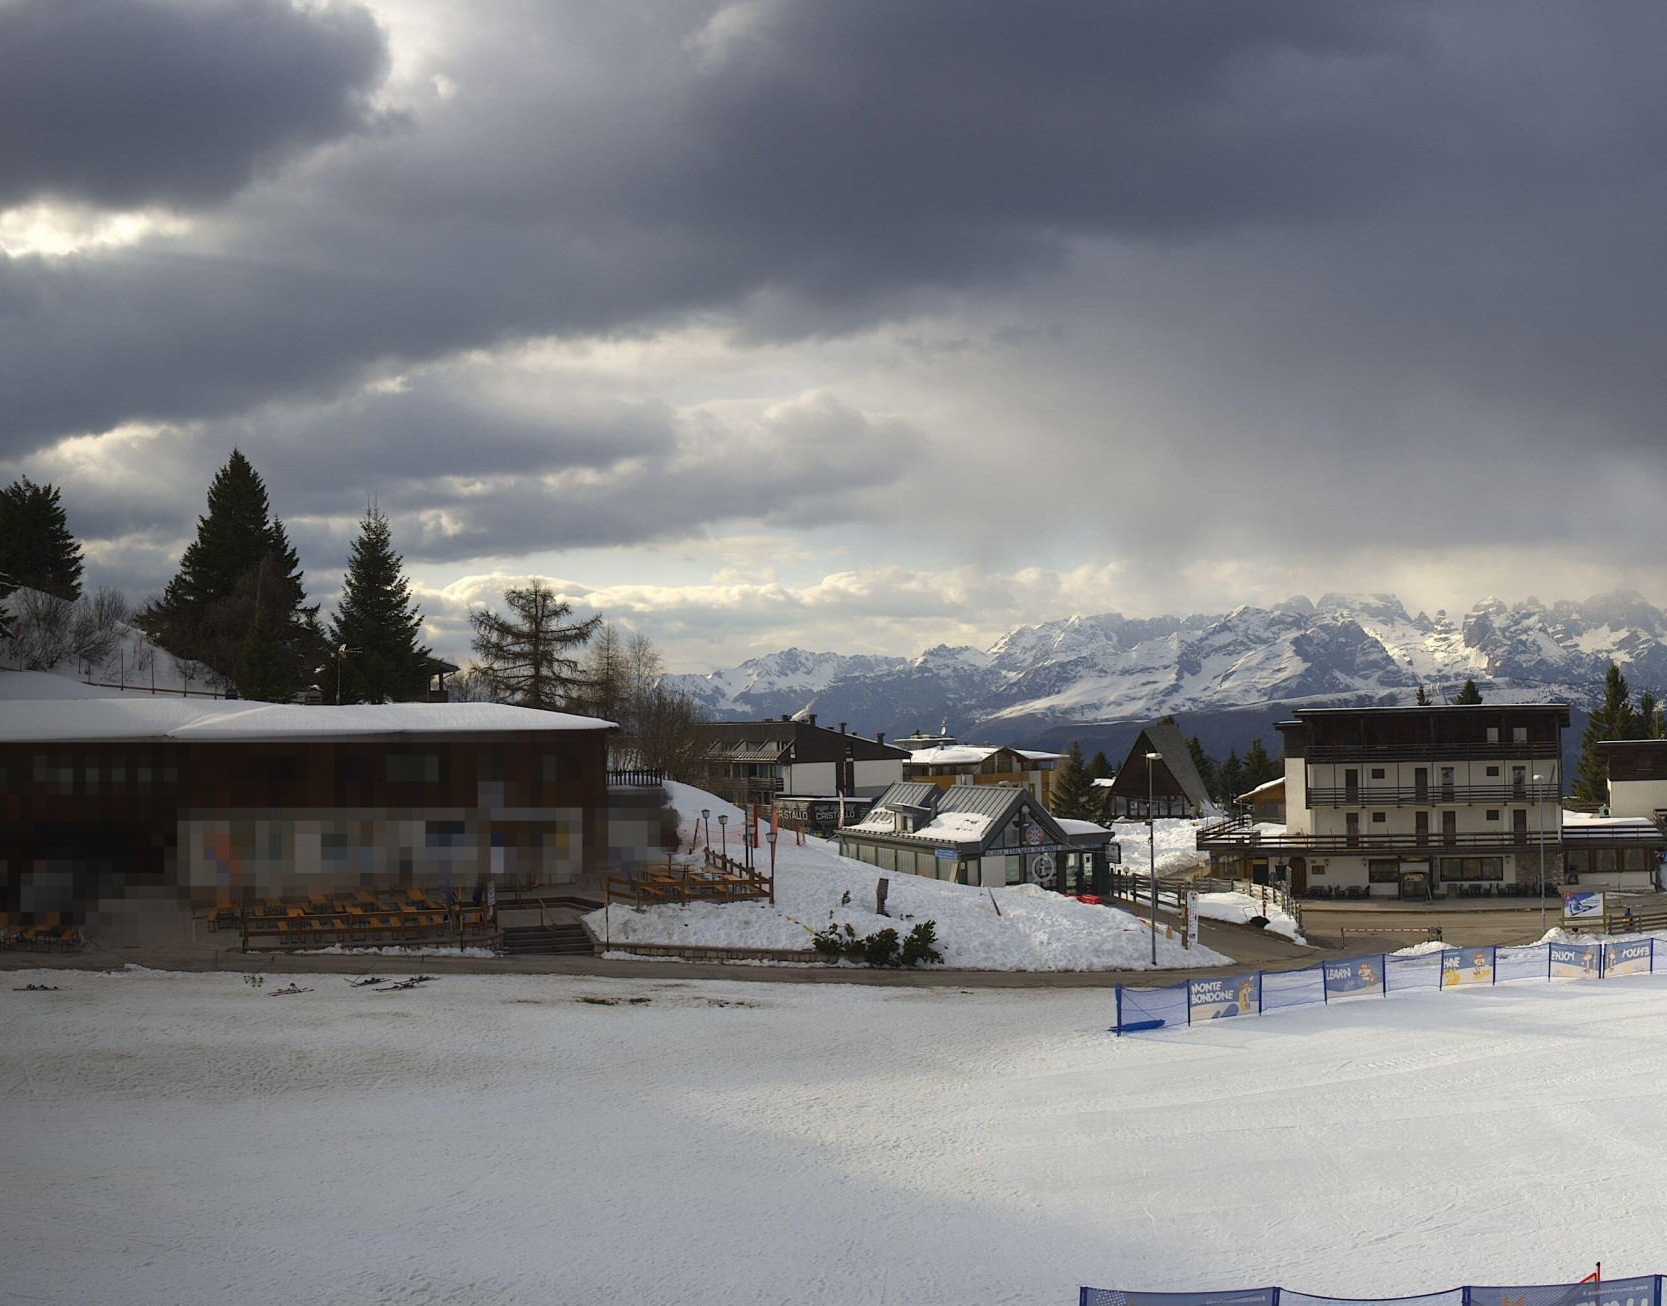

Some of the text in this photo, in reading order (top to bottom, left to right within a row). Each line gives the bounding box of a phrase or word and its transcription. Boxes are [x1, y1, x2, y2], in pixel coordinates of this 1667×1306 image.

[1551, 950, 1575, 961] ENJOY
[1326, 967, 1352, 981] LEARN
[1191, 981, 1223, 994] MONTE
[1191, 990, 1234, 1004] BONDONE
